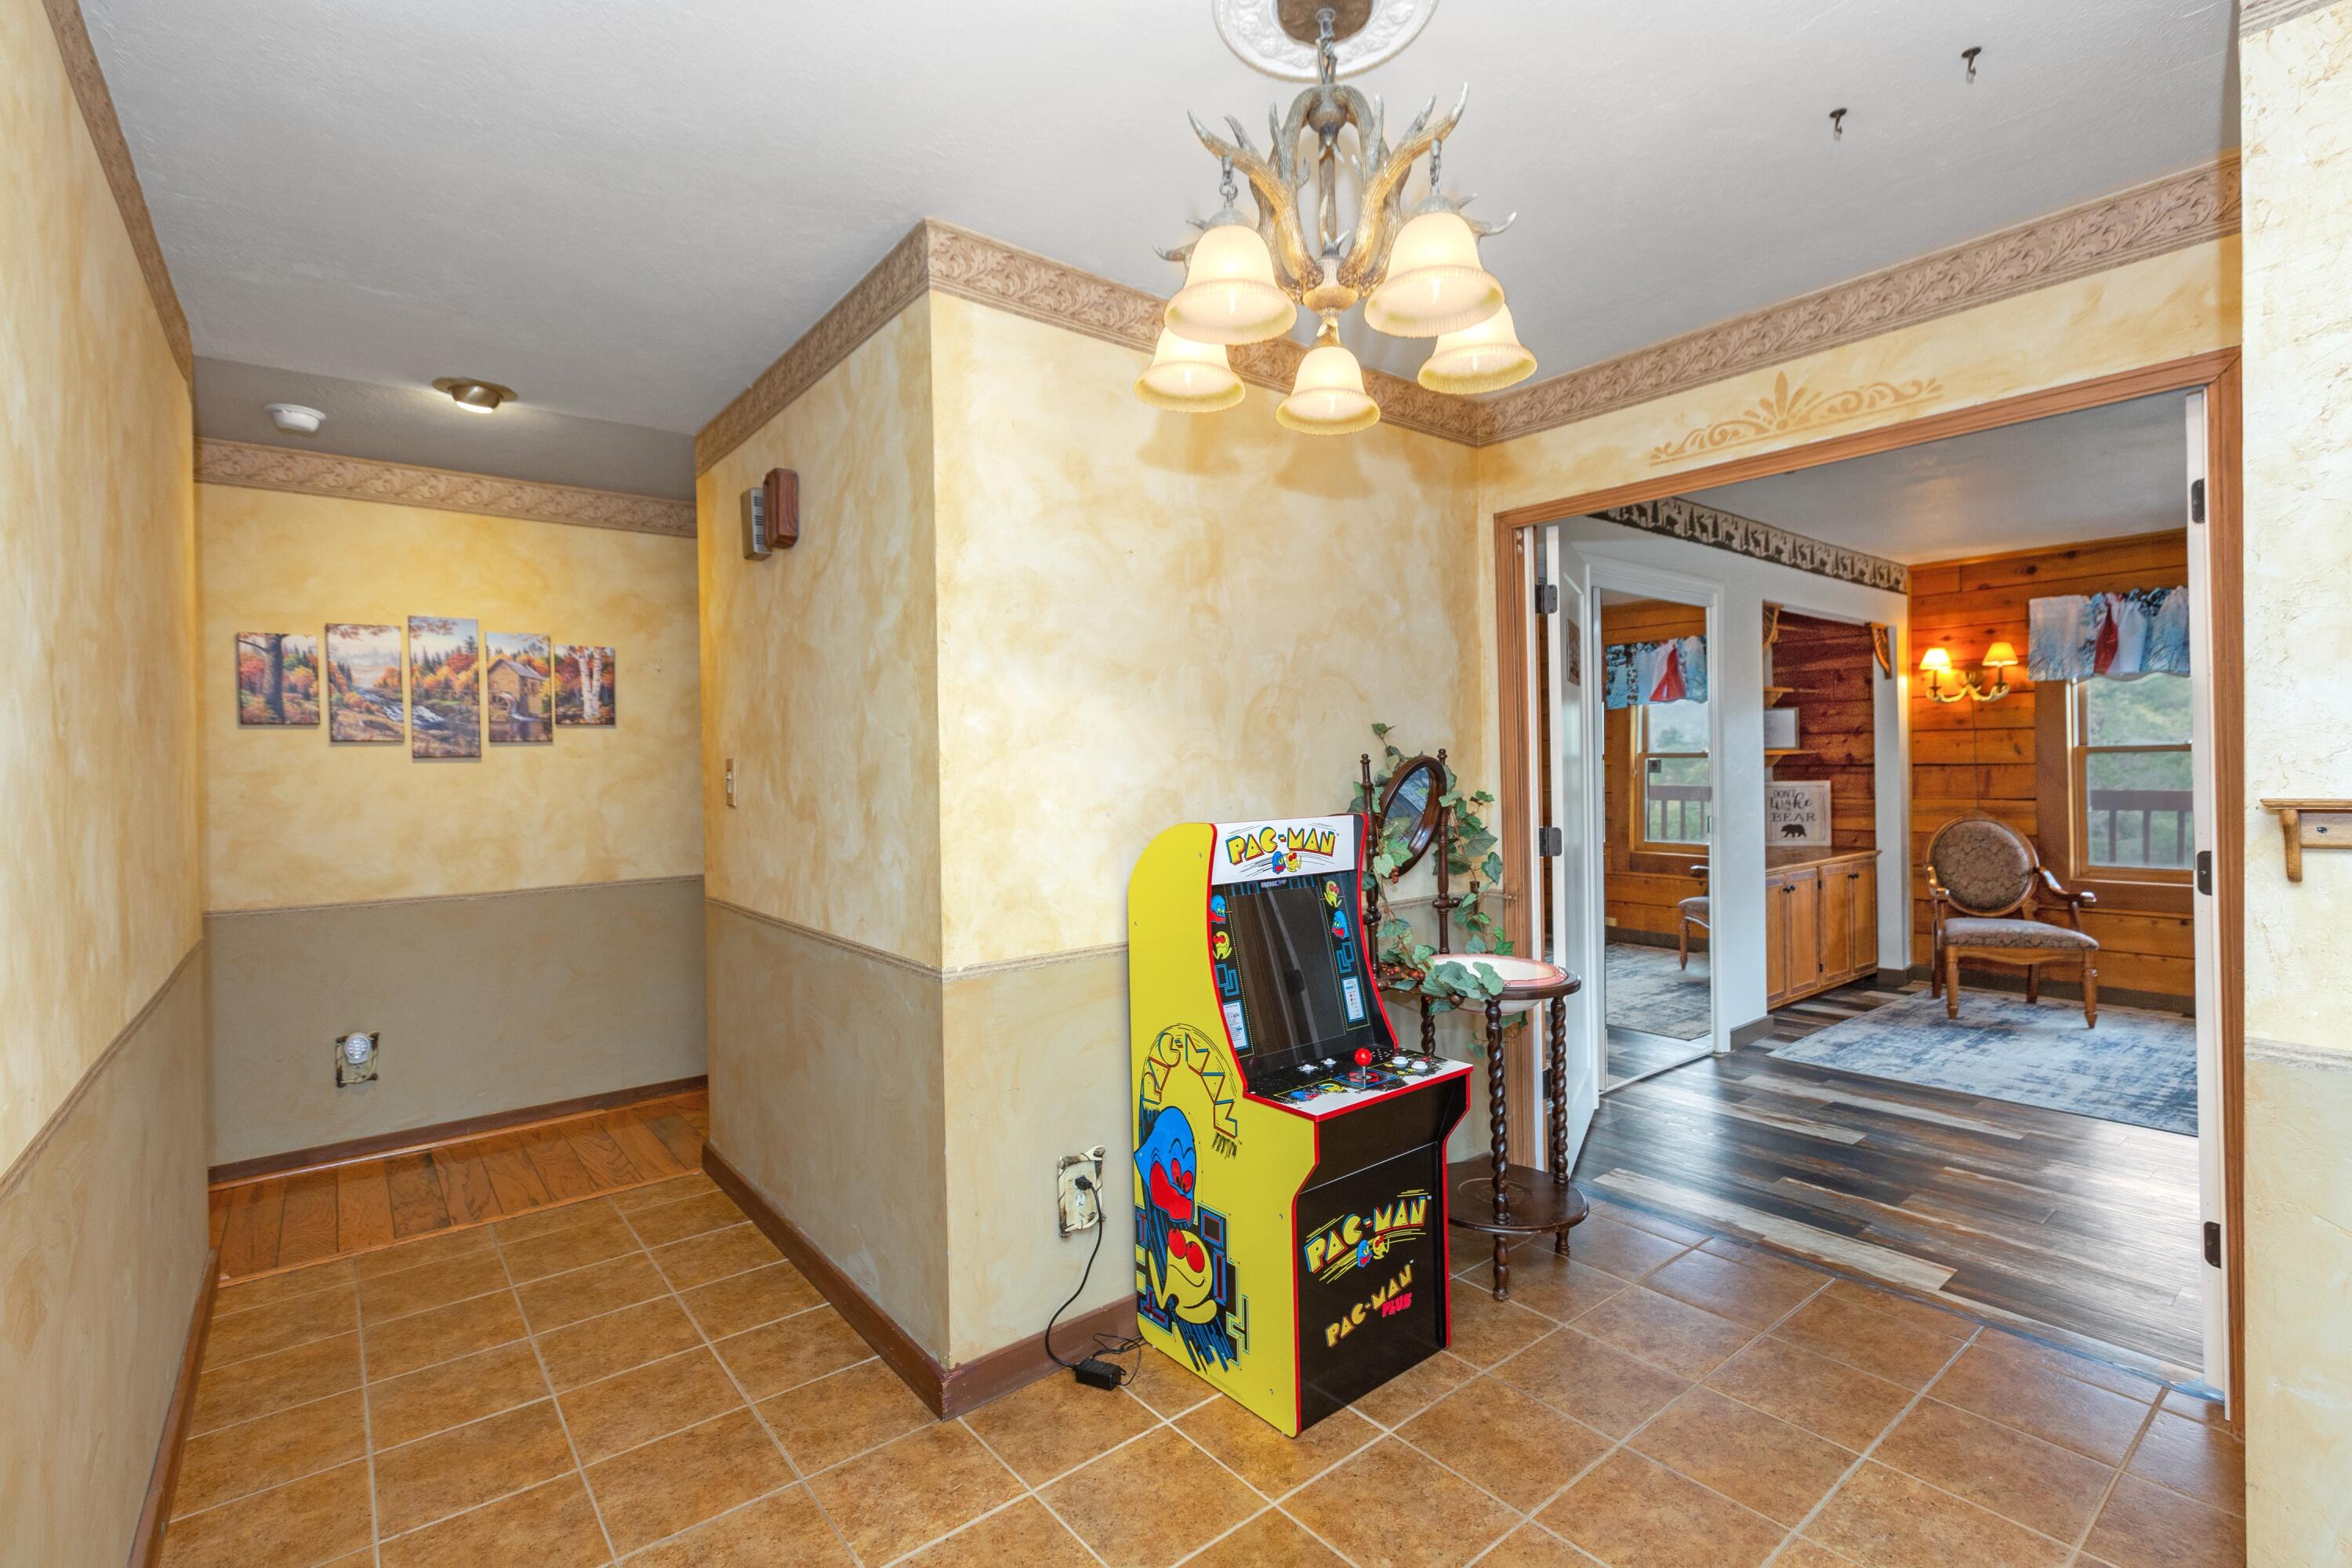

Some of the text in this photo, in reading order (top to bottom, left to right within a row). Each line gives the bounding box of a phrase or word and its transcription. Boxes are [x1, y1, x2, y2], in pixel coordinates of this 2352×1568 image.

[1225, 826, 1336, 866] PAC-MAN
[1770, 811, 1817, 822] BEAR
[1141, 1030, 1238, 1140] PAC-MAN
[1304, 1196, 1428, 1274] PAC-MAN
[1325, 1263, 1414, 1348] PAC-MAN
[1381, 1292, 1413, 1318] PLUS
